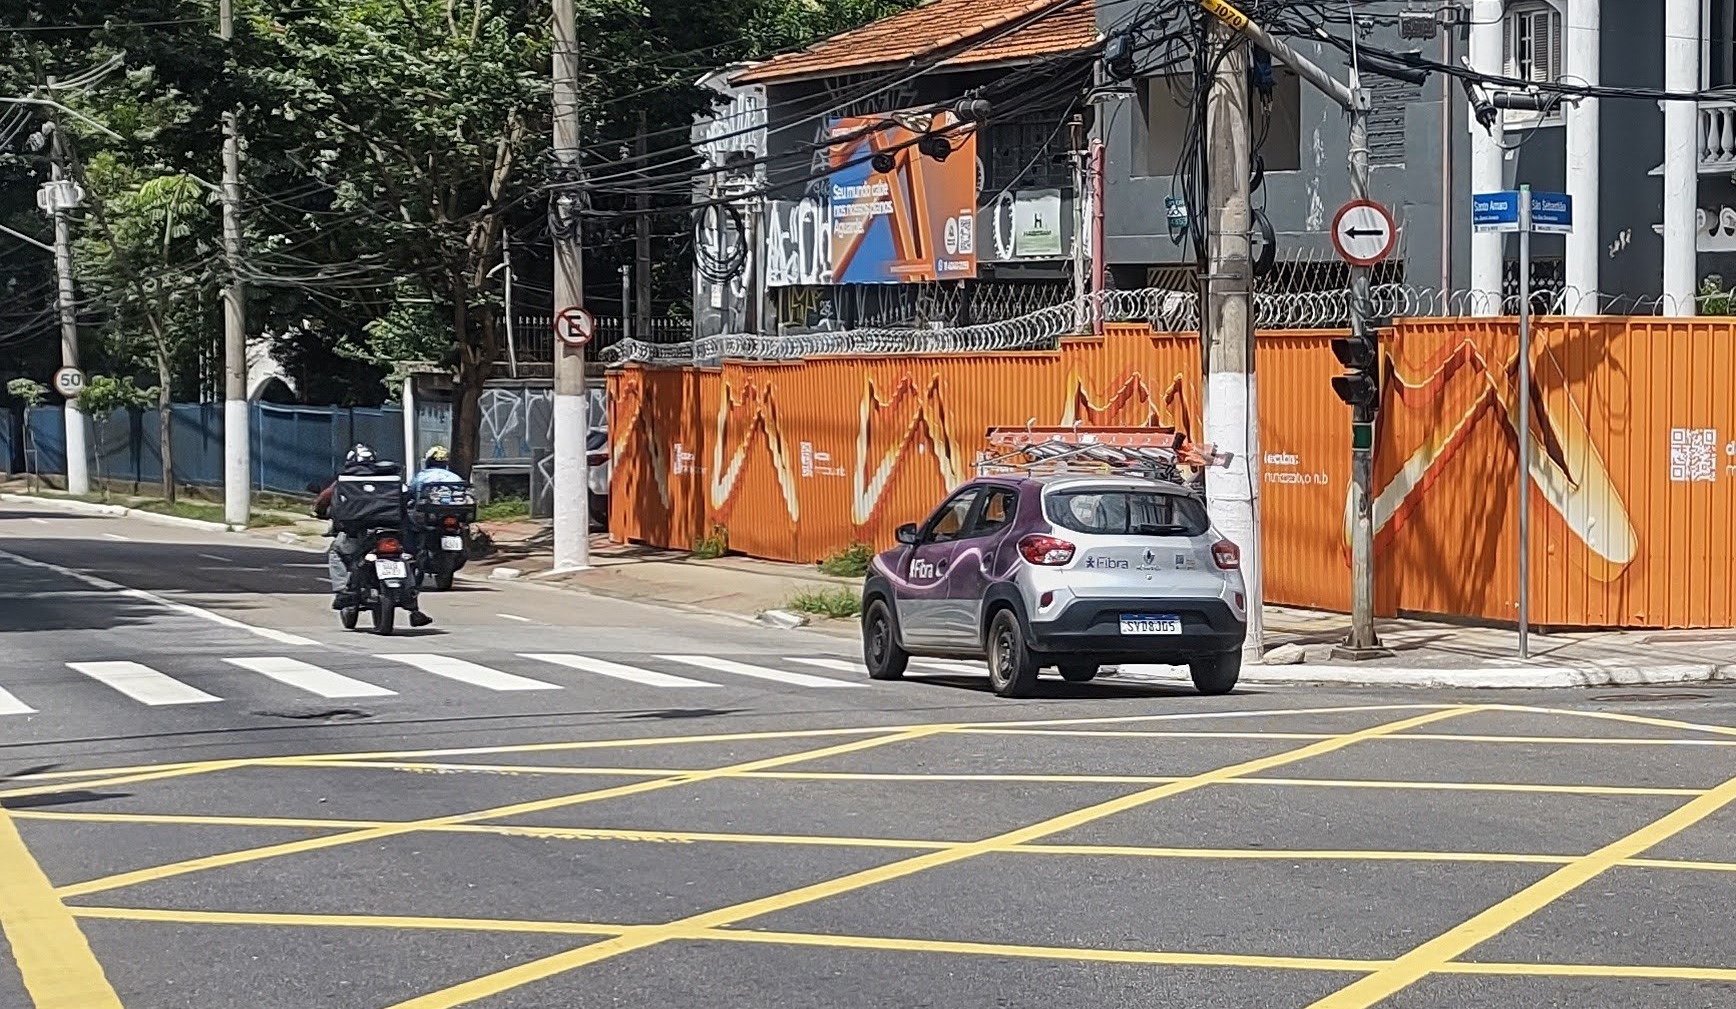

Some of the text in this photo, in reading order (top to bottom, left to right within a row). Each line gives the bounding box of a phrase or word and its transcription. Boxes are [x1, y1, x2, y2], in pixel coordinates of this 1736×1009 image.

[1214, 3, 1242, 27] 1070
[61, 373, 81, 387] 50
[1096, 556, 1129, 570] Fibra
